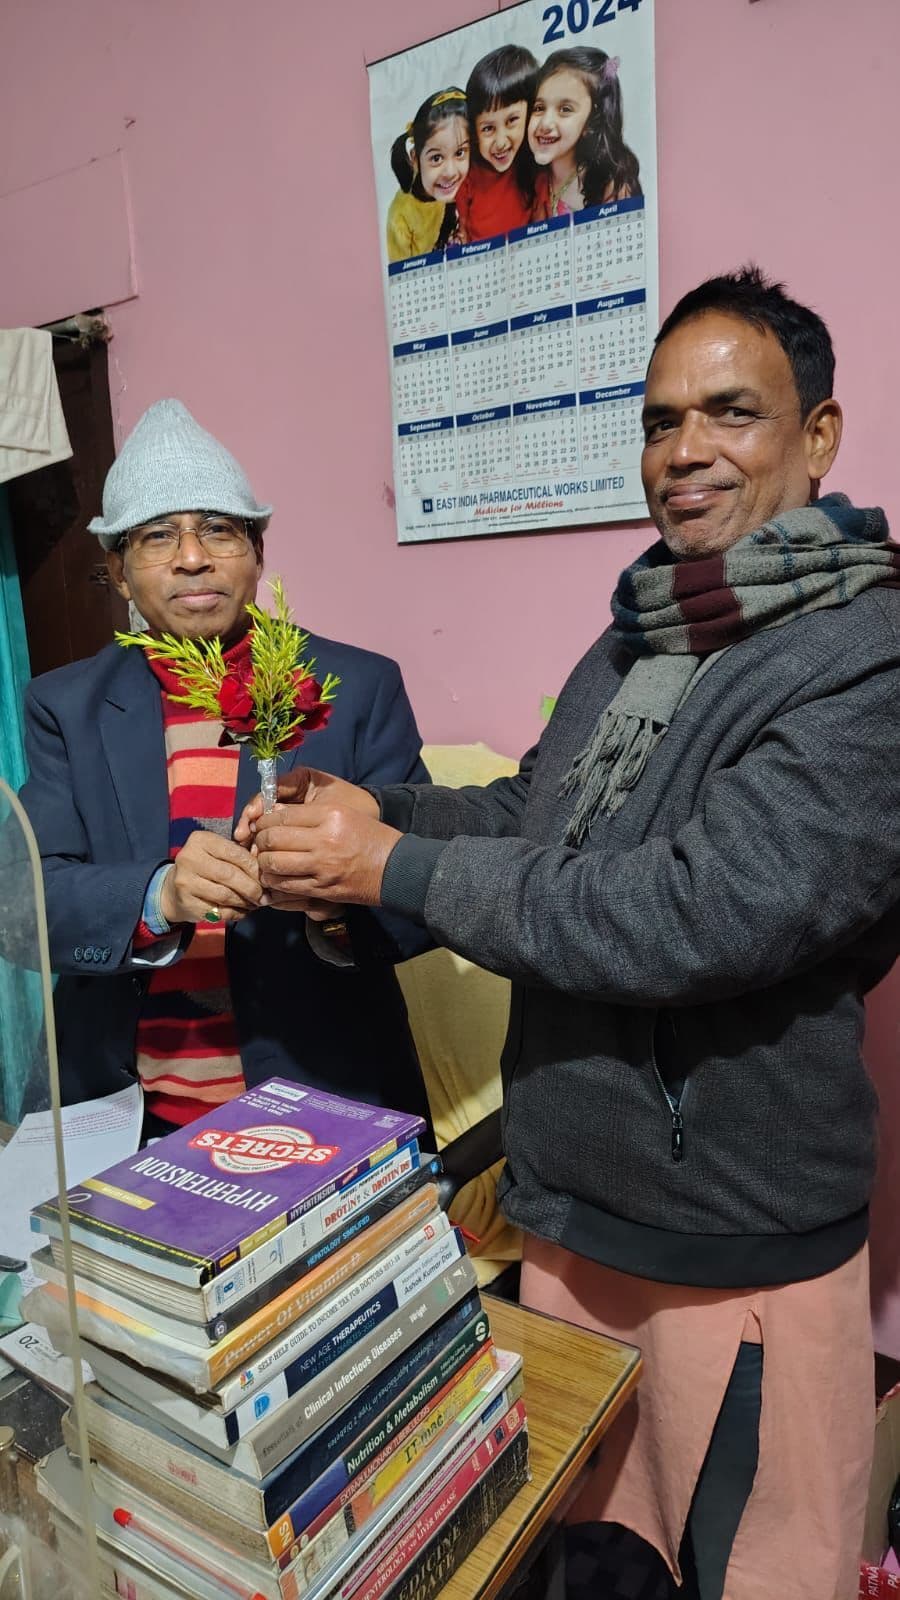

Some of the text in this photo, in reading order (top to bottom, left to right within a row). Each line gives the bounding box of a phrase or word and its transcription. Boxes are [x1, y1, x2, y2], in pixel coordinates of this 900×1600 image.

[541, 0, 641, 44] 202
[598, 204, 618, 216] April
[527, 223, 549, 235] March
[462, 242, 491, 254] February
[597, 296, 625, 309] August
[533, 313, 548, 323] July
[412, 343, 426, 351] May
[595, 386, 632, 399] December
[525, 399, 561, 410] November
[471, 411, 496, 421] October
[409, 421, 442, 432] September
[436, 476, 625, 511] EAST INDIA PHARMACEUTICAL WORKS LIMITED
[474, 499, 564, 516] Medicine for Millions
[196, 1131, 333, 1162] SECRETS
[129, 1156, 279, 1212] HYPERTENSION
[324, 1198, 357, 1227] DROTIN
[371, 1165, 399, 1193] DROTIN
[399, 1160, 411, 1174] DS
[290, 1182, 336, 1221] HYPERTENSION
[422, 1263, 441, 1282] Kumar
[289, 1332, 308, 1347] GUIDE
[317, 1305, 338, 1325] INCOME
[338, 1296, 350, 1308] TAX
[360, 1268, 384, 1289] DOCTORS
[19, 1335, 40, 1349] 20
[222, 1326, 275, 1367] Power
[276, 1307, 294, 1326] Of
[300, 1301, 382, 1373] NEW AGE THERAPEUTICS
[303, 1389, 334, 1420] Clinical
[334, 1356, 371, 1396] Infectious
[371, 1327, 403, 1360] Diseases
[409, 1303, 428, 1324] Wright
[347, 1377, 438, 1473] Nutrition & Metabolism
[867, 1566, 880, 1598] PATNA
